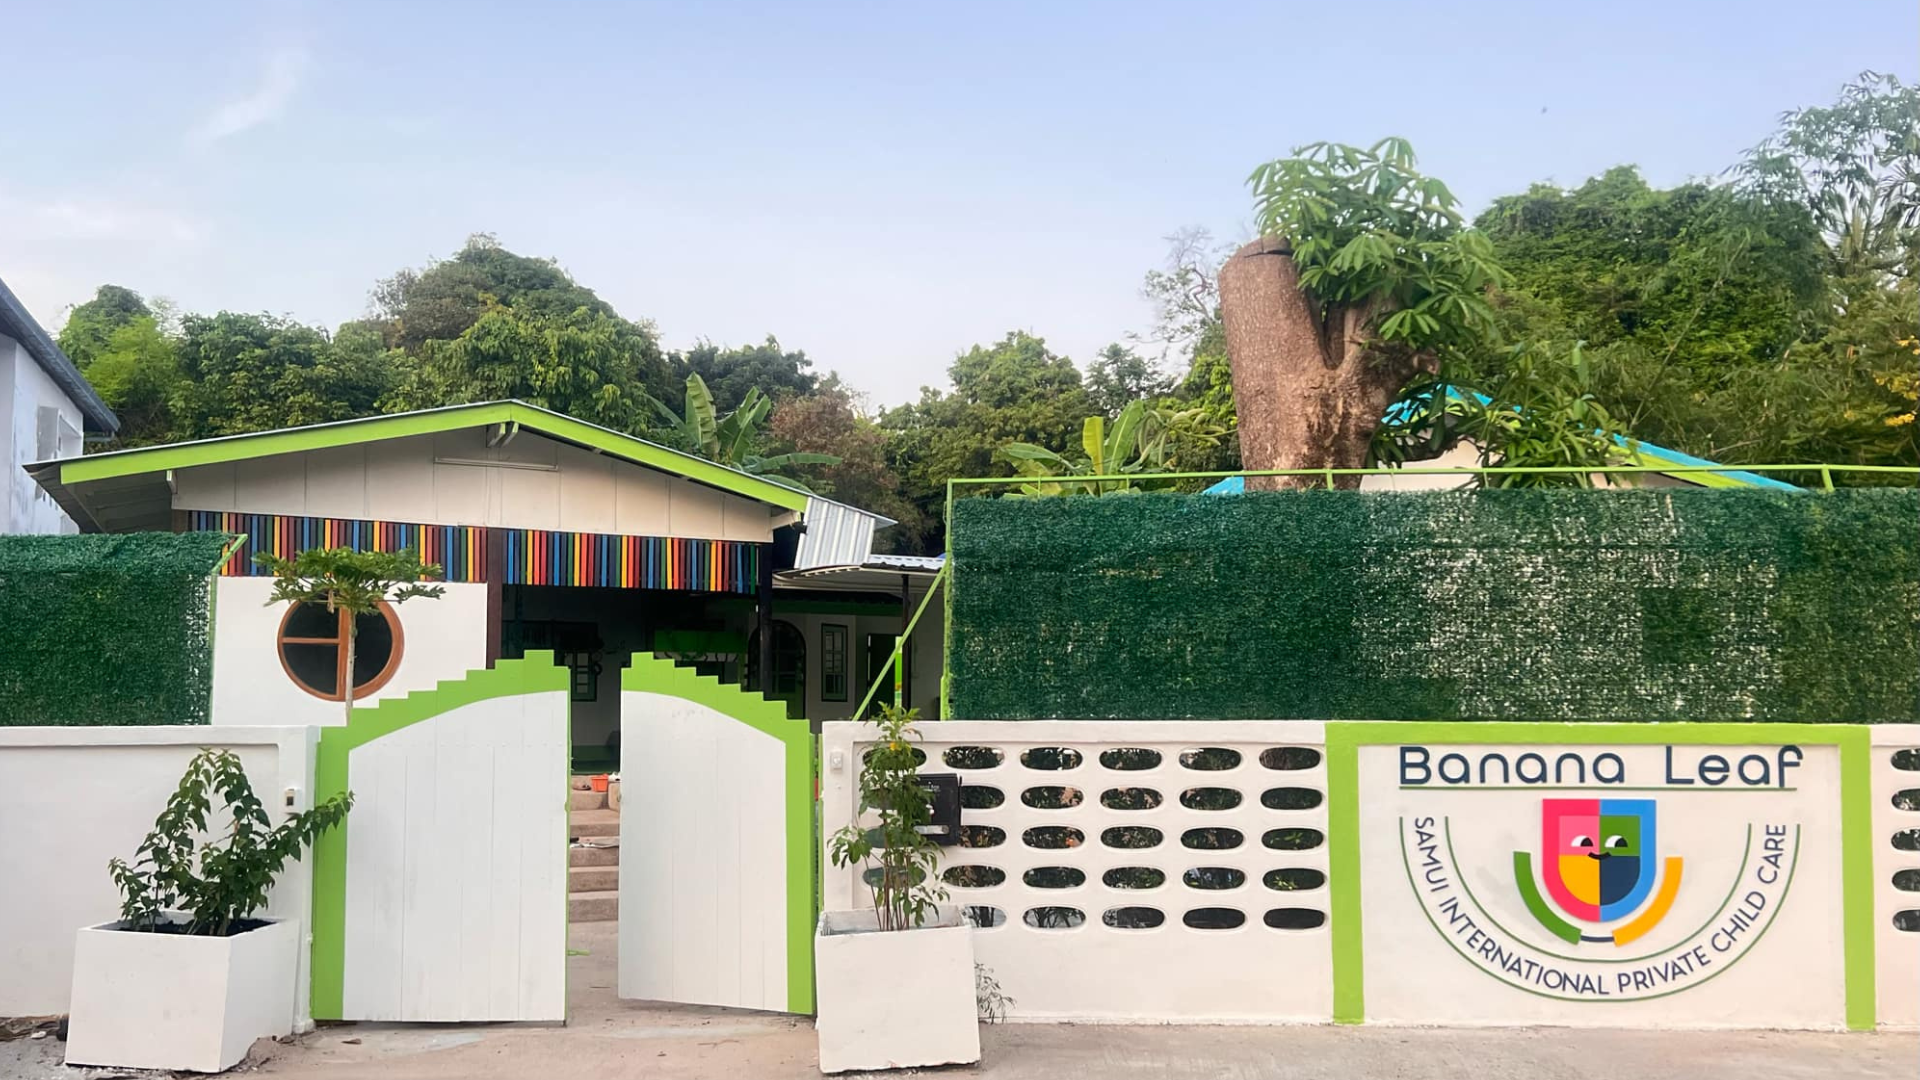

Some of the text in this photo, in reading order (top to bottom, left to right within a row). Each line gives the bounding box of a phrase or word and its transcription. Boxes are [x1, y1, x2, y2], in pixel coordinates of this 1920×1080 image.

[1399, 745, 1804, 788] Banana Leaf
[1414, 816, 1786, 995] SAMUI INTERNATIONAL PRIVATE CHILD CARE
